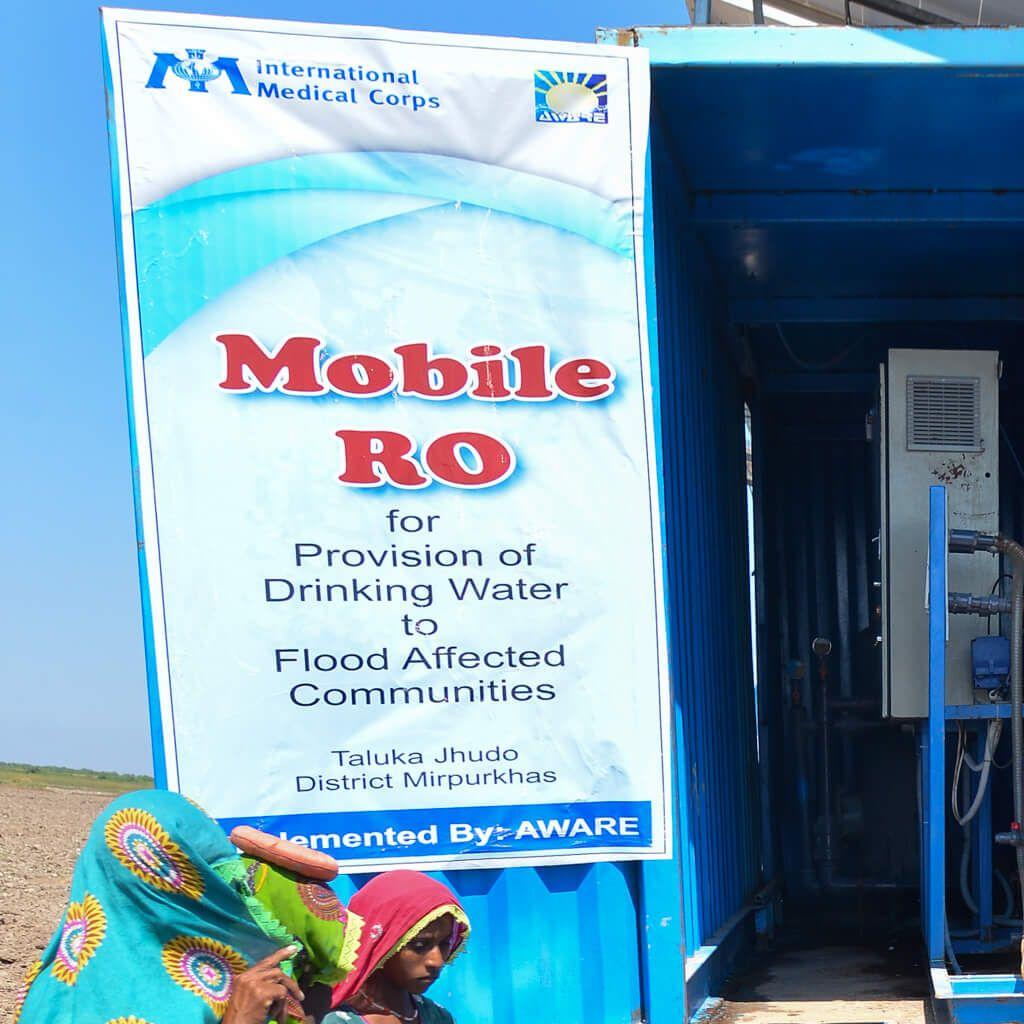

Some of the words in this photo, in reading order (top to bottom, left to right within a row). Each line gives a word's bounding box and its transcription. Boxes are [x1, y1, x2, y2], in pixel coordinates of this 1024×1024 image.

[256, 59, 418, 85] International
[257, 82, 358, 104] Medical
[369, 89, 440, 111] Corps
[215, 333, 612, 399] Mobile
[334, 429, 511, 487] RO
[385, 509, 440, 533] for
[294, 543, 483, 567] Provision
[498, 543, 537, 566] of
[264, 578, 433, 607] Drinking
[448, 577, 569, 601] Water
[401, 614, 438, 636] to
[274, 648, 389, 672] Flood
[402, 644, 565, 670] Affected
[289, 679, 556, 707] Communities
[331, 749, 423, 767] Taluka
[434, 746, 519, 763] Jhudo
[295, 772, 393, 792] District
[403, 768, 557, 791] Mirpurkhas
[514, 817, 640, 840] AWARE
